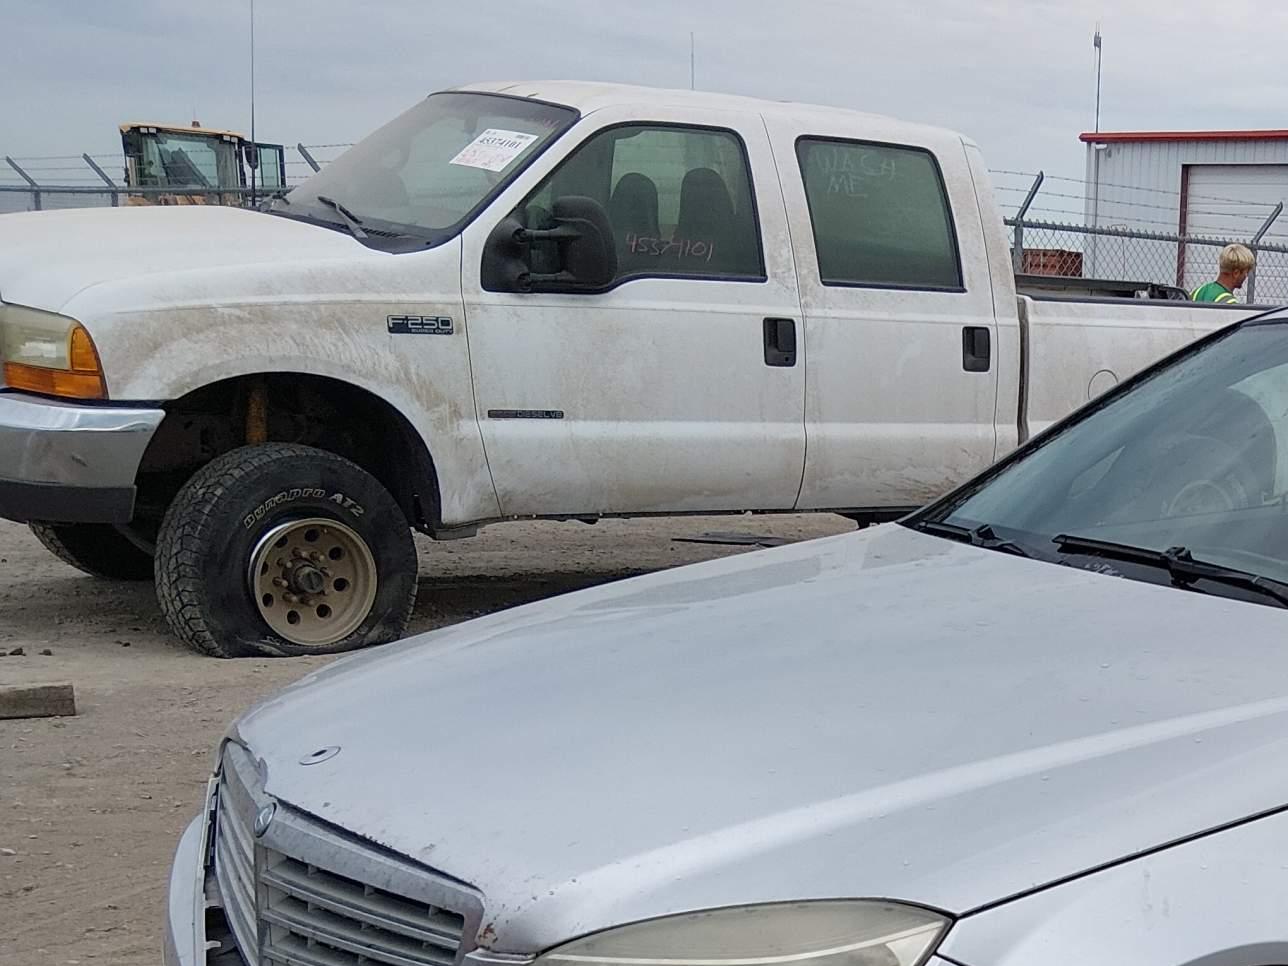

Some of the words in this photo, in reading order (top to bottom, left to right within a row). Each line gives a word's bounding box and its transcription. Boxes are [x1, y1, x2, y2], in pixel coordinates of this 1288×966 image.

[827, 173, 868, 199] ME
[625, 232, 713, 263] 45374101
[328, 492, 365, 518] AT2
